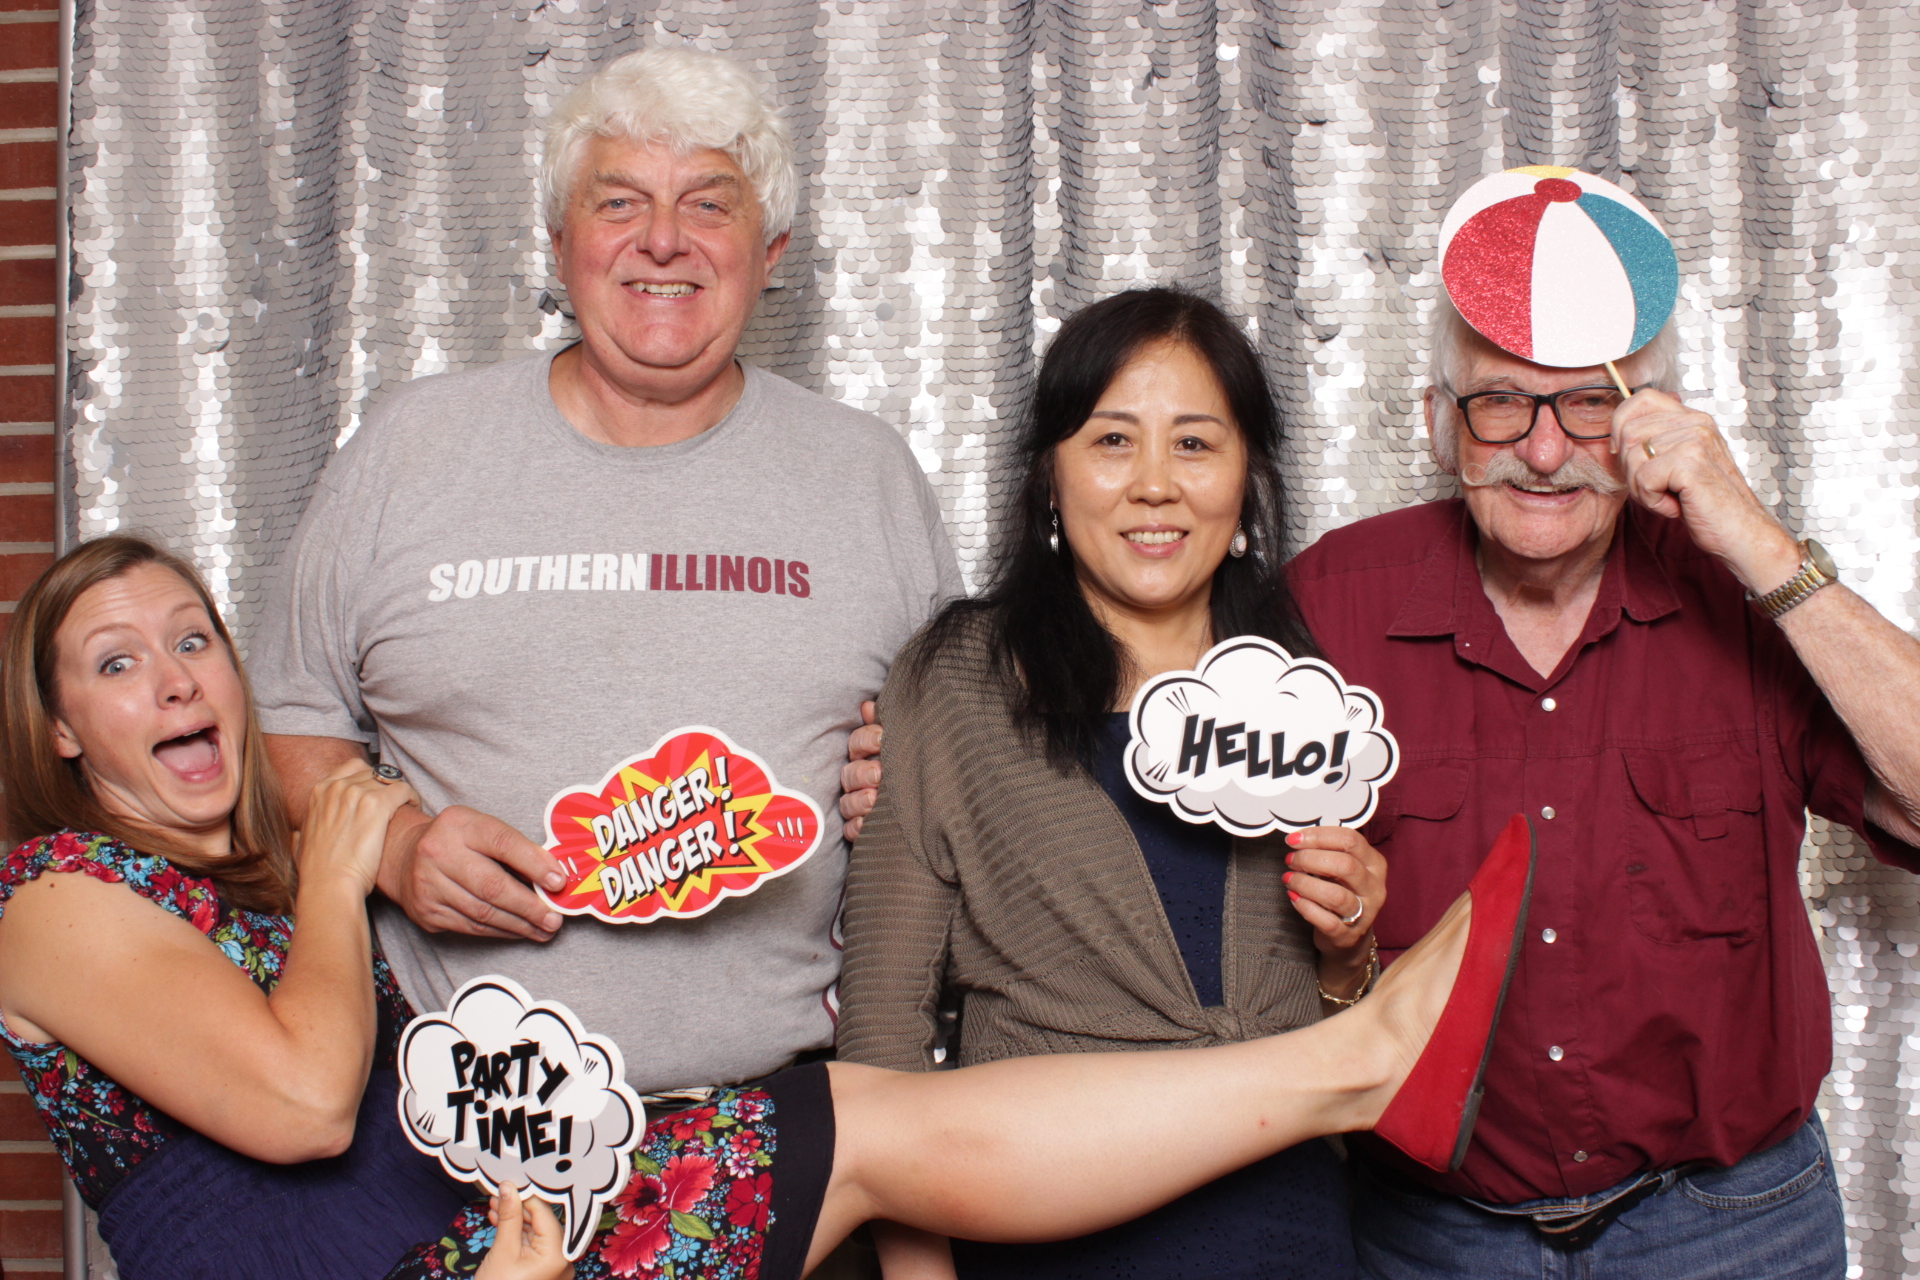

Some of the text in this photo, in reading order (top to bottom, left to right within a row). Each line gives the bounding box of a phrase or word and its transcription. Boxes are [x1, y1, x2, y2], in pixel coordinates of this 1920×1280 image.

[427, 553, 812, 602] SOUTHERN ILLINOIS
[1176, 713, 1351, 785] HELLO!
[590, 755, 733, 859] DANGER!
[597, 809, 741, 911] DANGER!
[450, 1040, 570, 1107] PARTY
